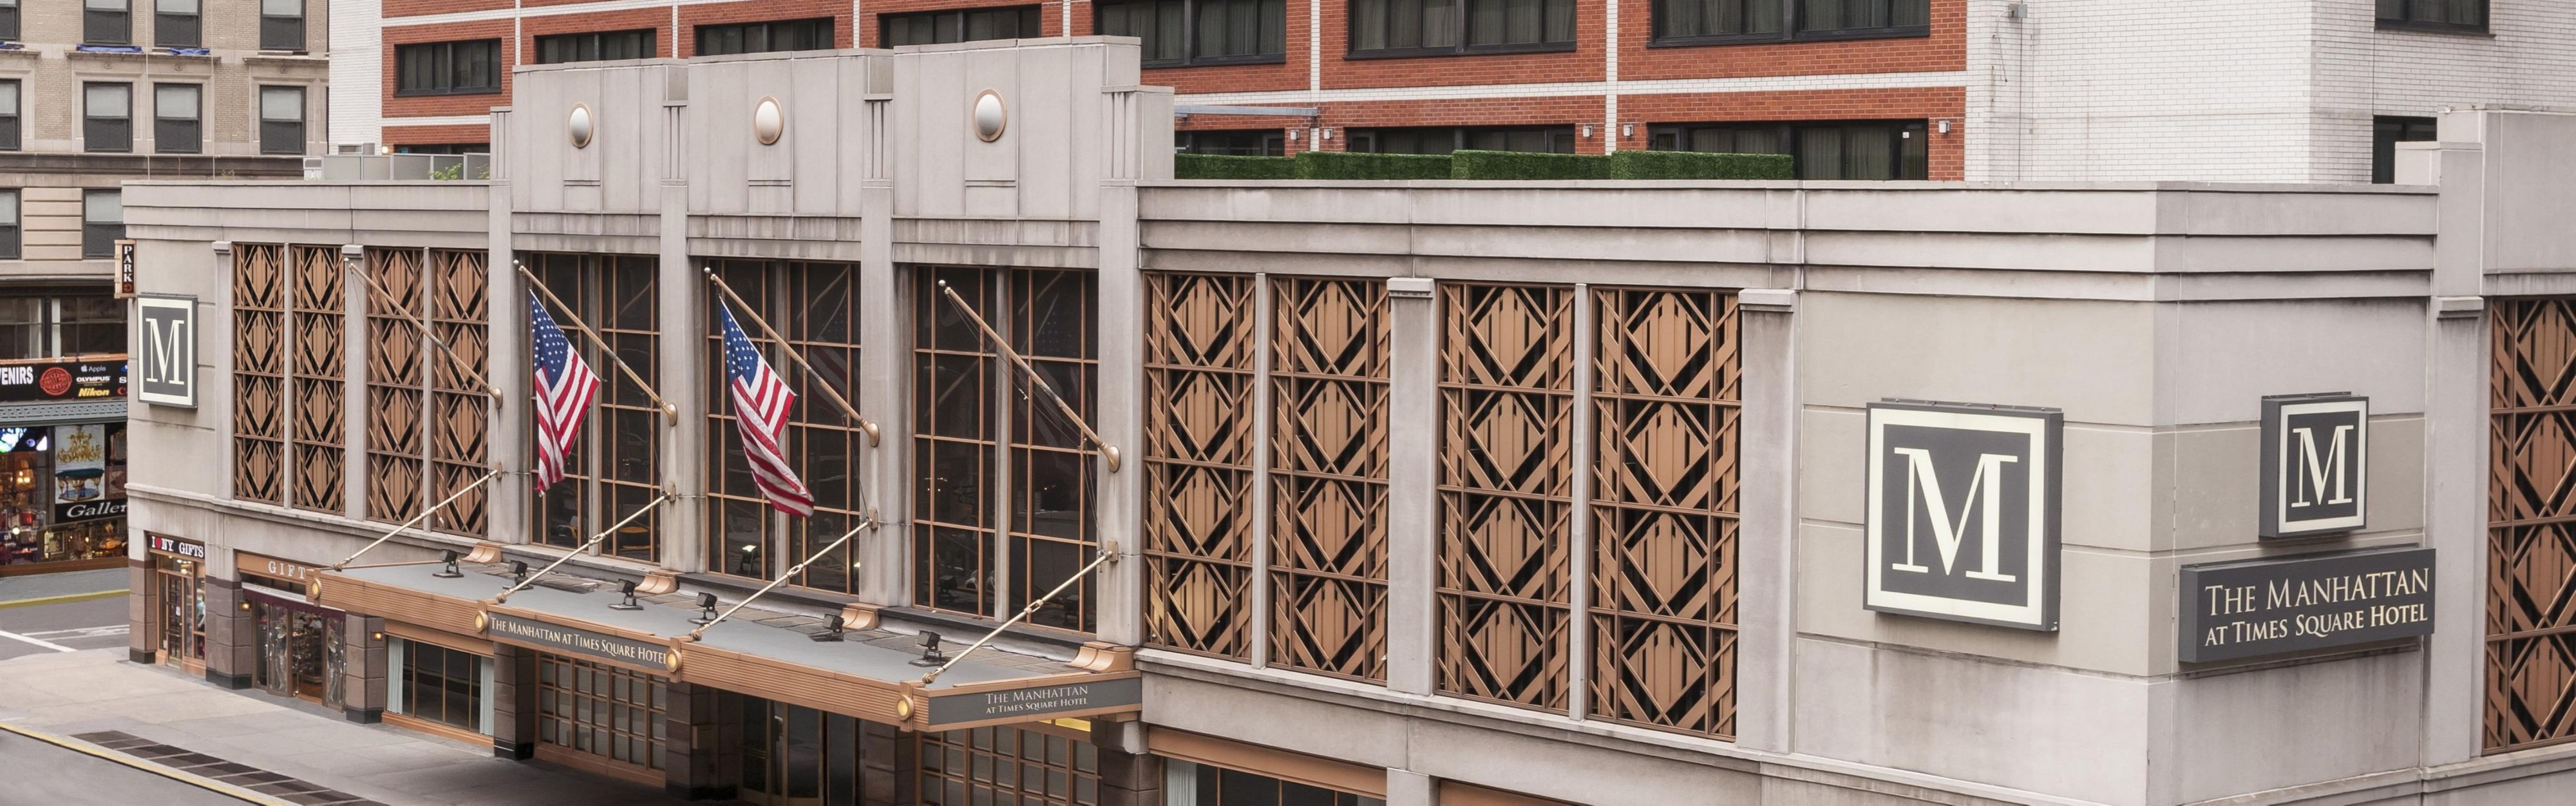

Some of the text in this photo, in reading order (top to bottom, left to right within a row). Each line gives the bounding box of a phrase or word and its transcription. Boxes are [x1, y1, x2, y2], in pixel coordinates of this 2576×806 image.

[124, 245, 133, 282] PARK
[146, 318, 185, 385] M
[0, 366, 33, 385] ENIRS
[78, 388, 110, 397] Nikon
[2291, 425, 2354, 508] M
[1892, 447, 2018, 582] M
[178, 542, 204, 558] GIFTS
[268, 561, 305, 579] GIFT
[2205, 568, 2429, 616] THE MANHATTAN
[490, 617, 507, 631] THE
[508, 621, 560, 642] MANHATTAN
[562, 633, 573, 645] AT
[573, 633, 600, 651] TIMES
[601, 639, 636, 658] SQUARE
[2204, 603, 2428, 646] AT TIMES SQUARE HOTEL
[985, 686, 1088, 704] THE MANHATTAN
[998, 704, 1023, 713] TIMES
[1025, 701, 1057, 711] SQUARE
[1061, 698, 1088, 707] HOTEL
